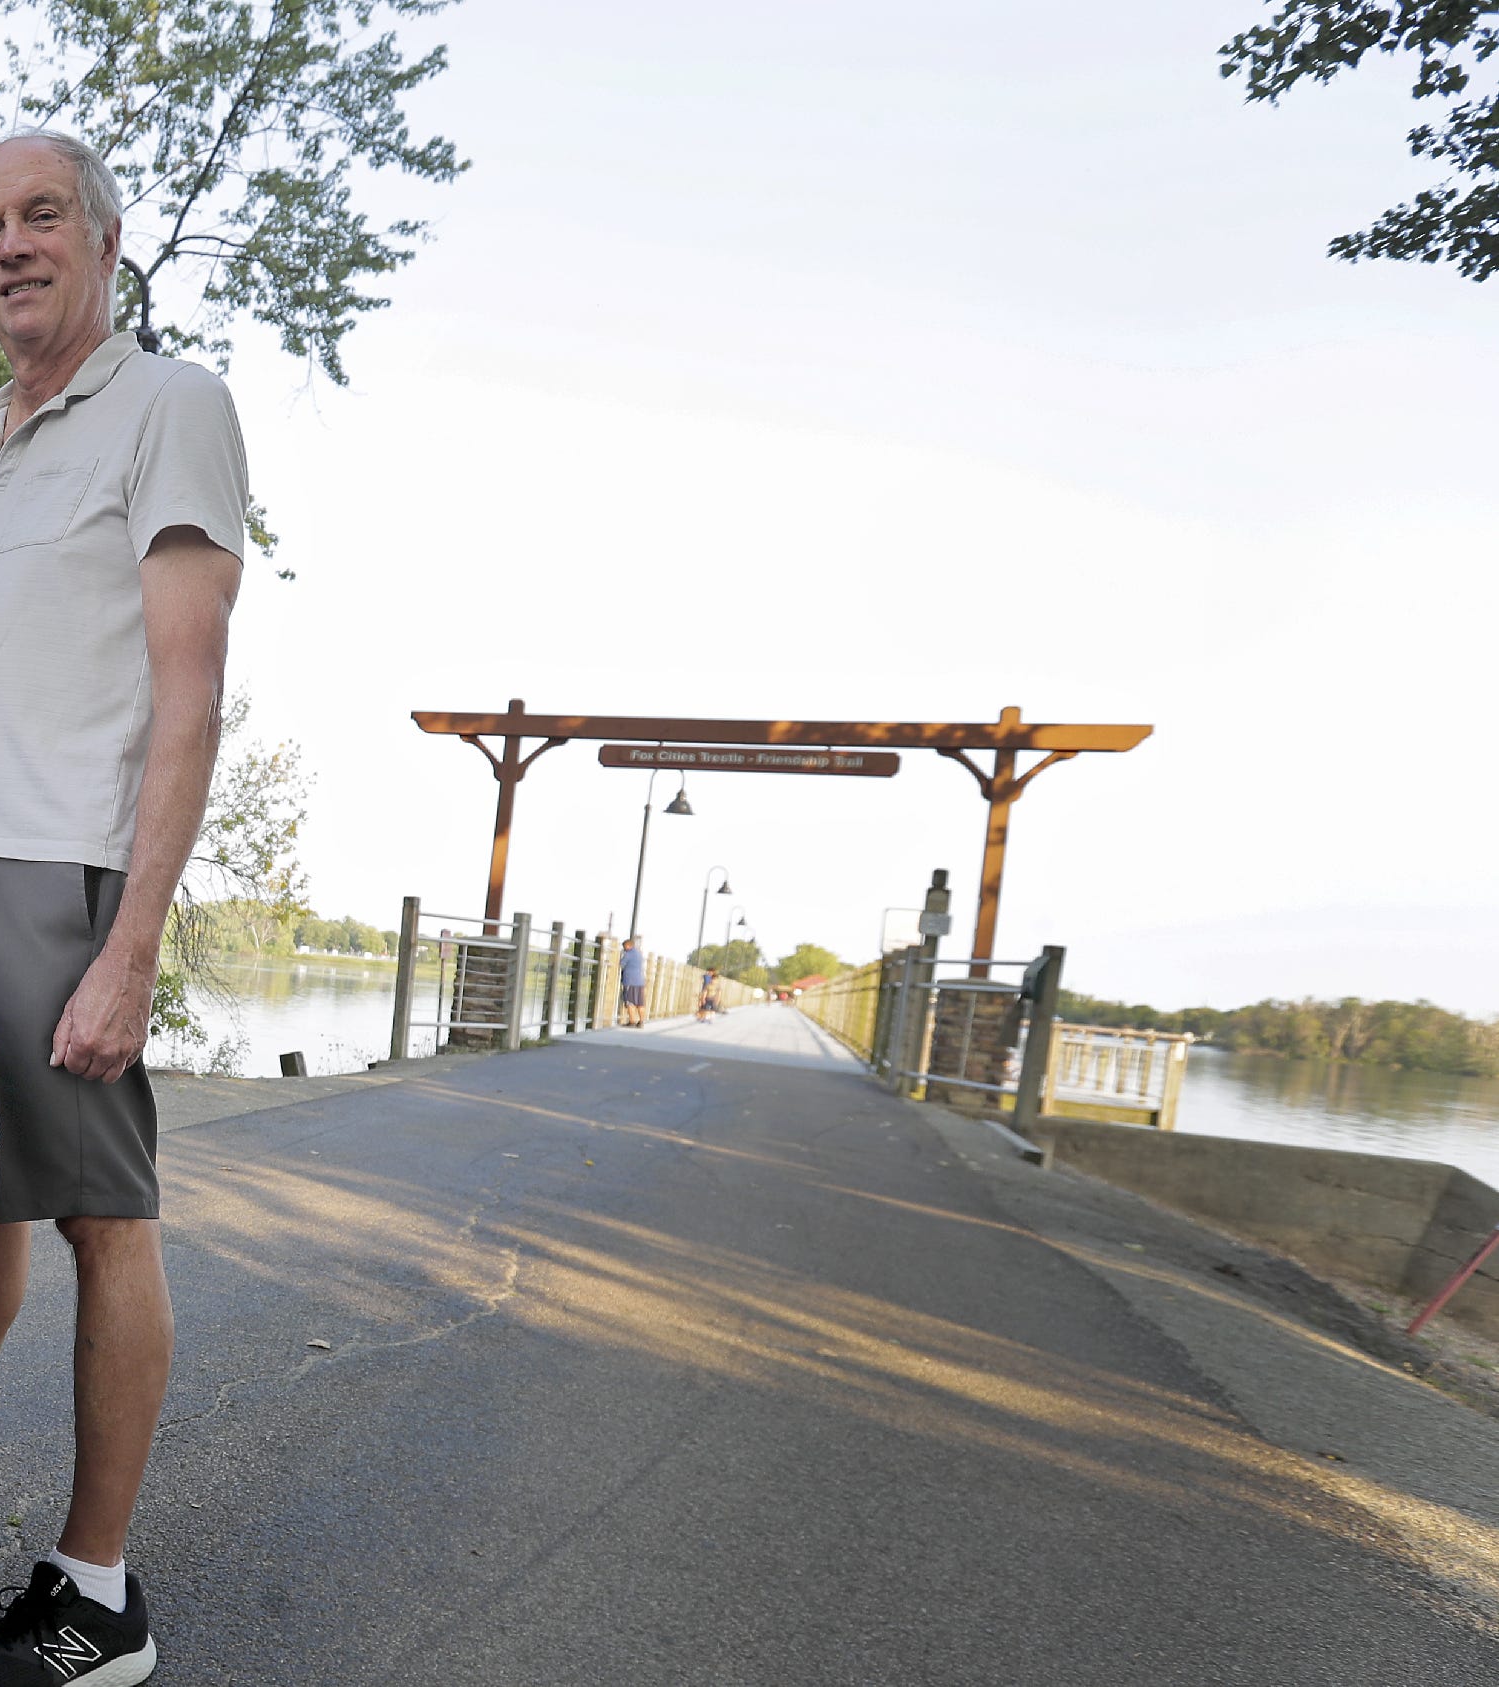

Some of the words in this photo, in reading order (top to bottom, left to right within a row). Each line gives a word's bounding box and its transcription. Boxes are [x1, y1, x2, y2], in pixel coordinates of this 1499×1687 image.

[629, 749, 655, 761] Fox
[659, 750, 697, 762] Cities
[700, 751, 746, 764] Trestle
[755, 752, 830, 769] Friendship
[835, 755, 864, 768] Trail
